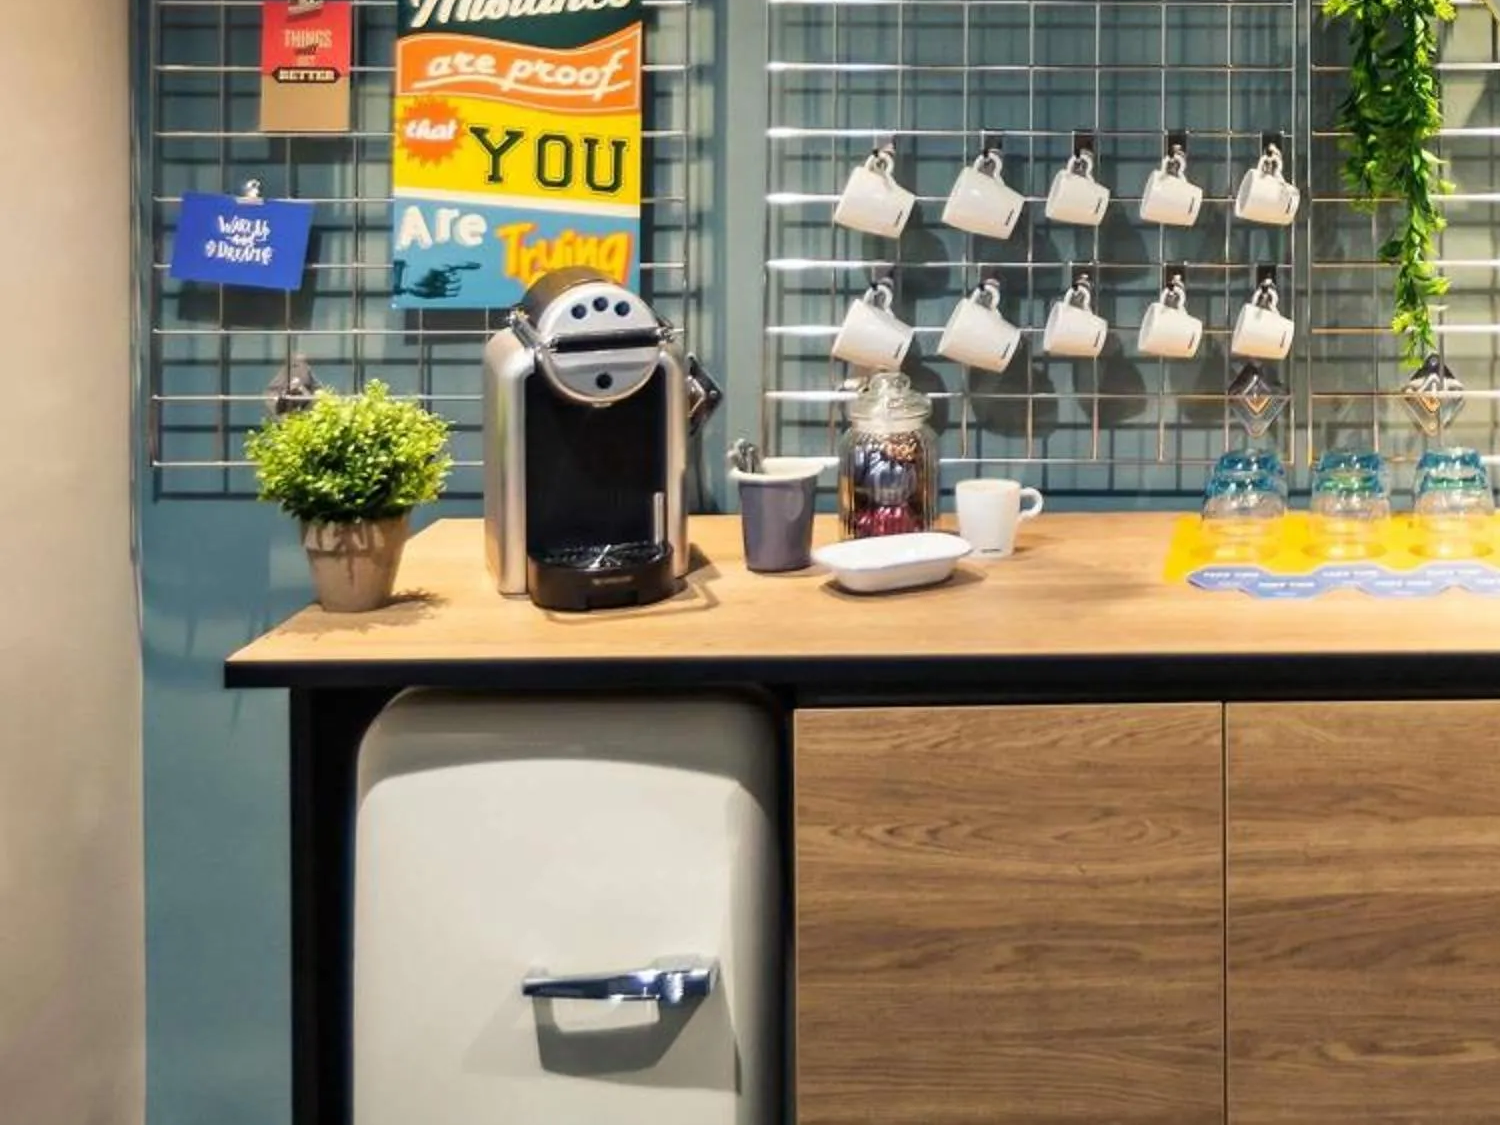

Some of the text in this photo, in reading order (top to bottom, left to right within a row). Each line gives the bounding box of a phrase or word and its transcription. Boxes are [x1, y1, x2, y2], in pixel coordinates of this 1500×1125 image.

[283, 28, 333, 48] THINGS
[278, 69, 336, 81] BETTER
[426, 48, 630, 97] are proof
[404, 118, 630, 194] that YOU
[398, 206, 488, 250] Are
